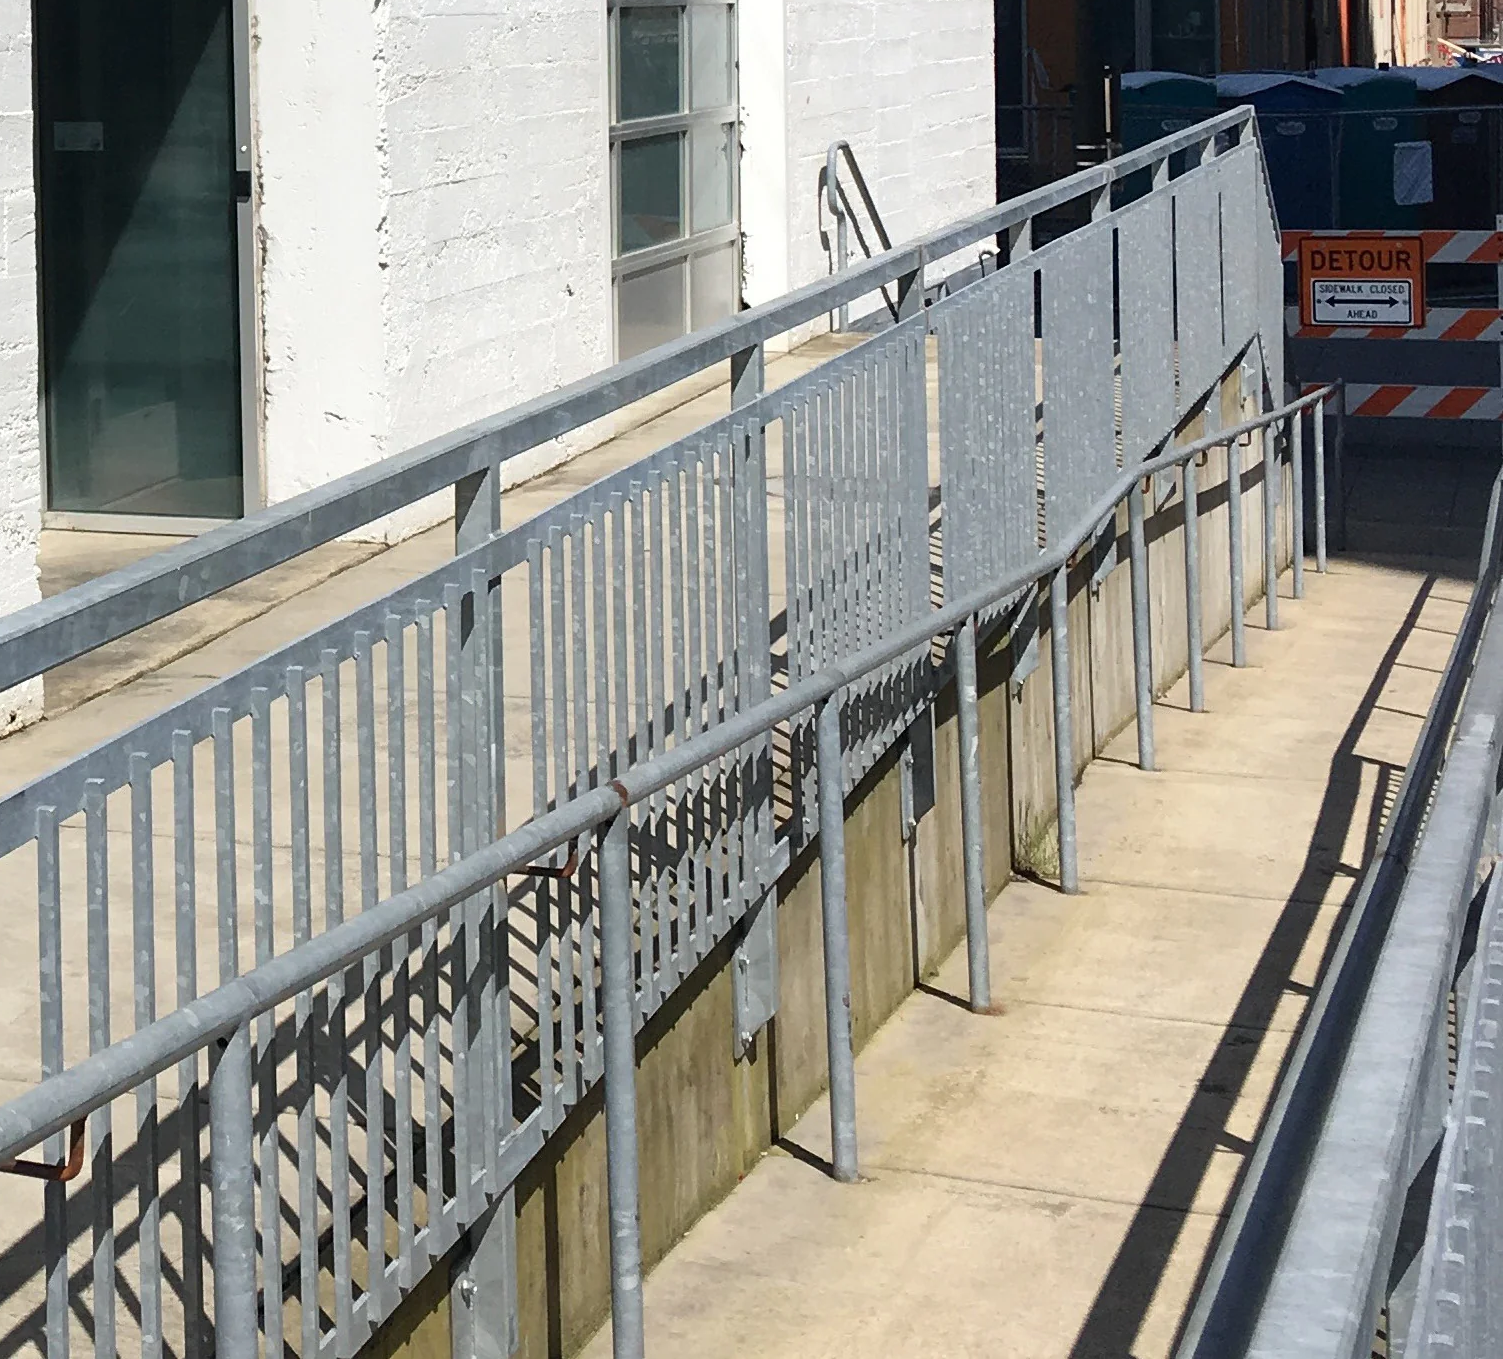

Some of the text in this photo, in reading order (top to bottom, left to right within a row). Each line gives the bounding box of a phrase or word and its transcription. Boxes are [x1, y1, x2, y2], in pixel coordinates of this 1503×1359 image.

[1310, 249, 1412, 272] DETOUR
[1319, 284, 1405, 294] SIDEWALK CLOSED
[1346, 309, 1378, 319] AHEAD
